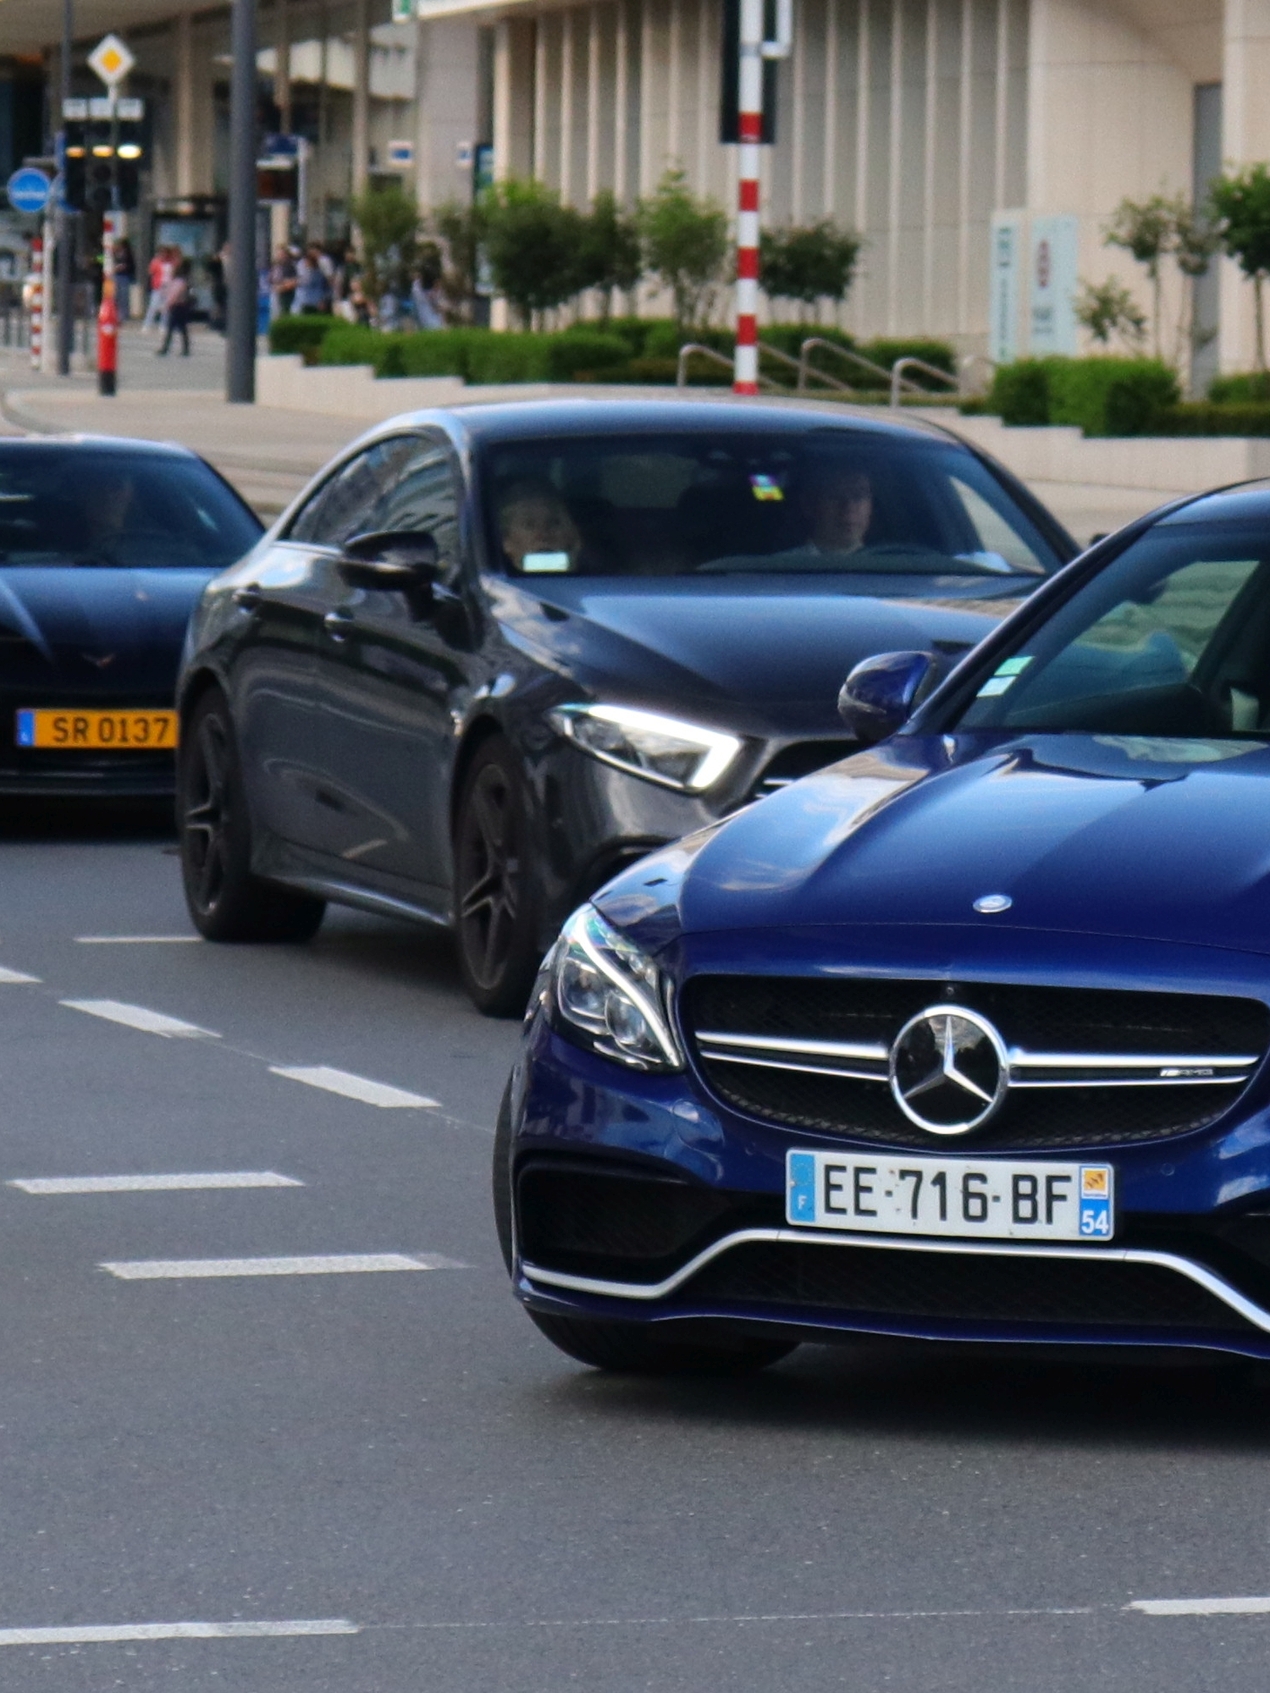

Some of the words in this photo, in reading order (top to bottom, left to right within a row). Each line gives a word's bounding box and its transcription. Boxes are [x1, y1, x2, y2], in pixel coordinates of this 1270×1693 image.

[52, 716, 89, 743] SR
[98, 716, 170, 743] 0137
[1081, 1209, 1109, 1234] 54
